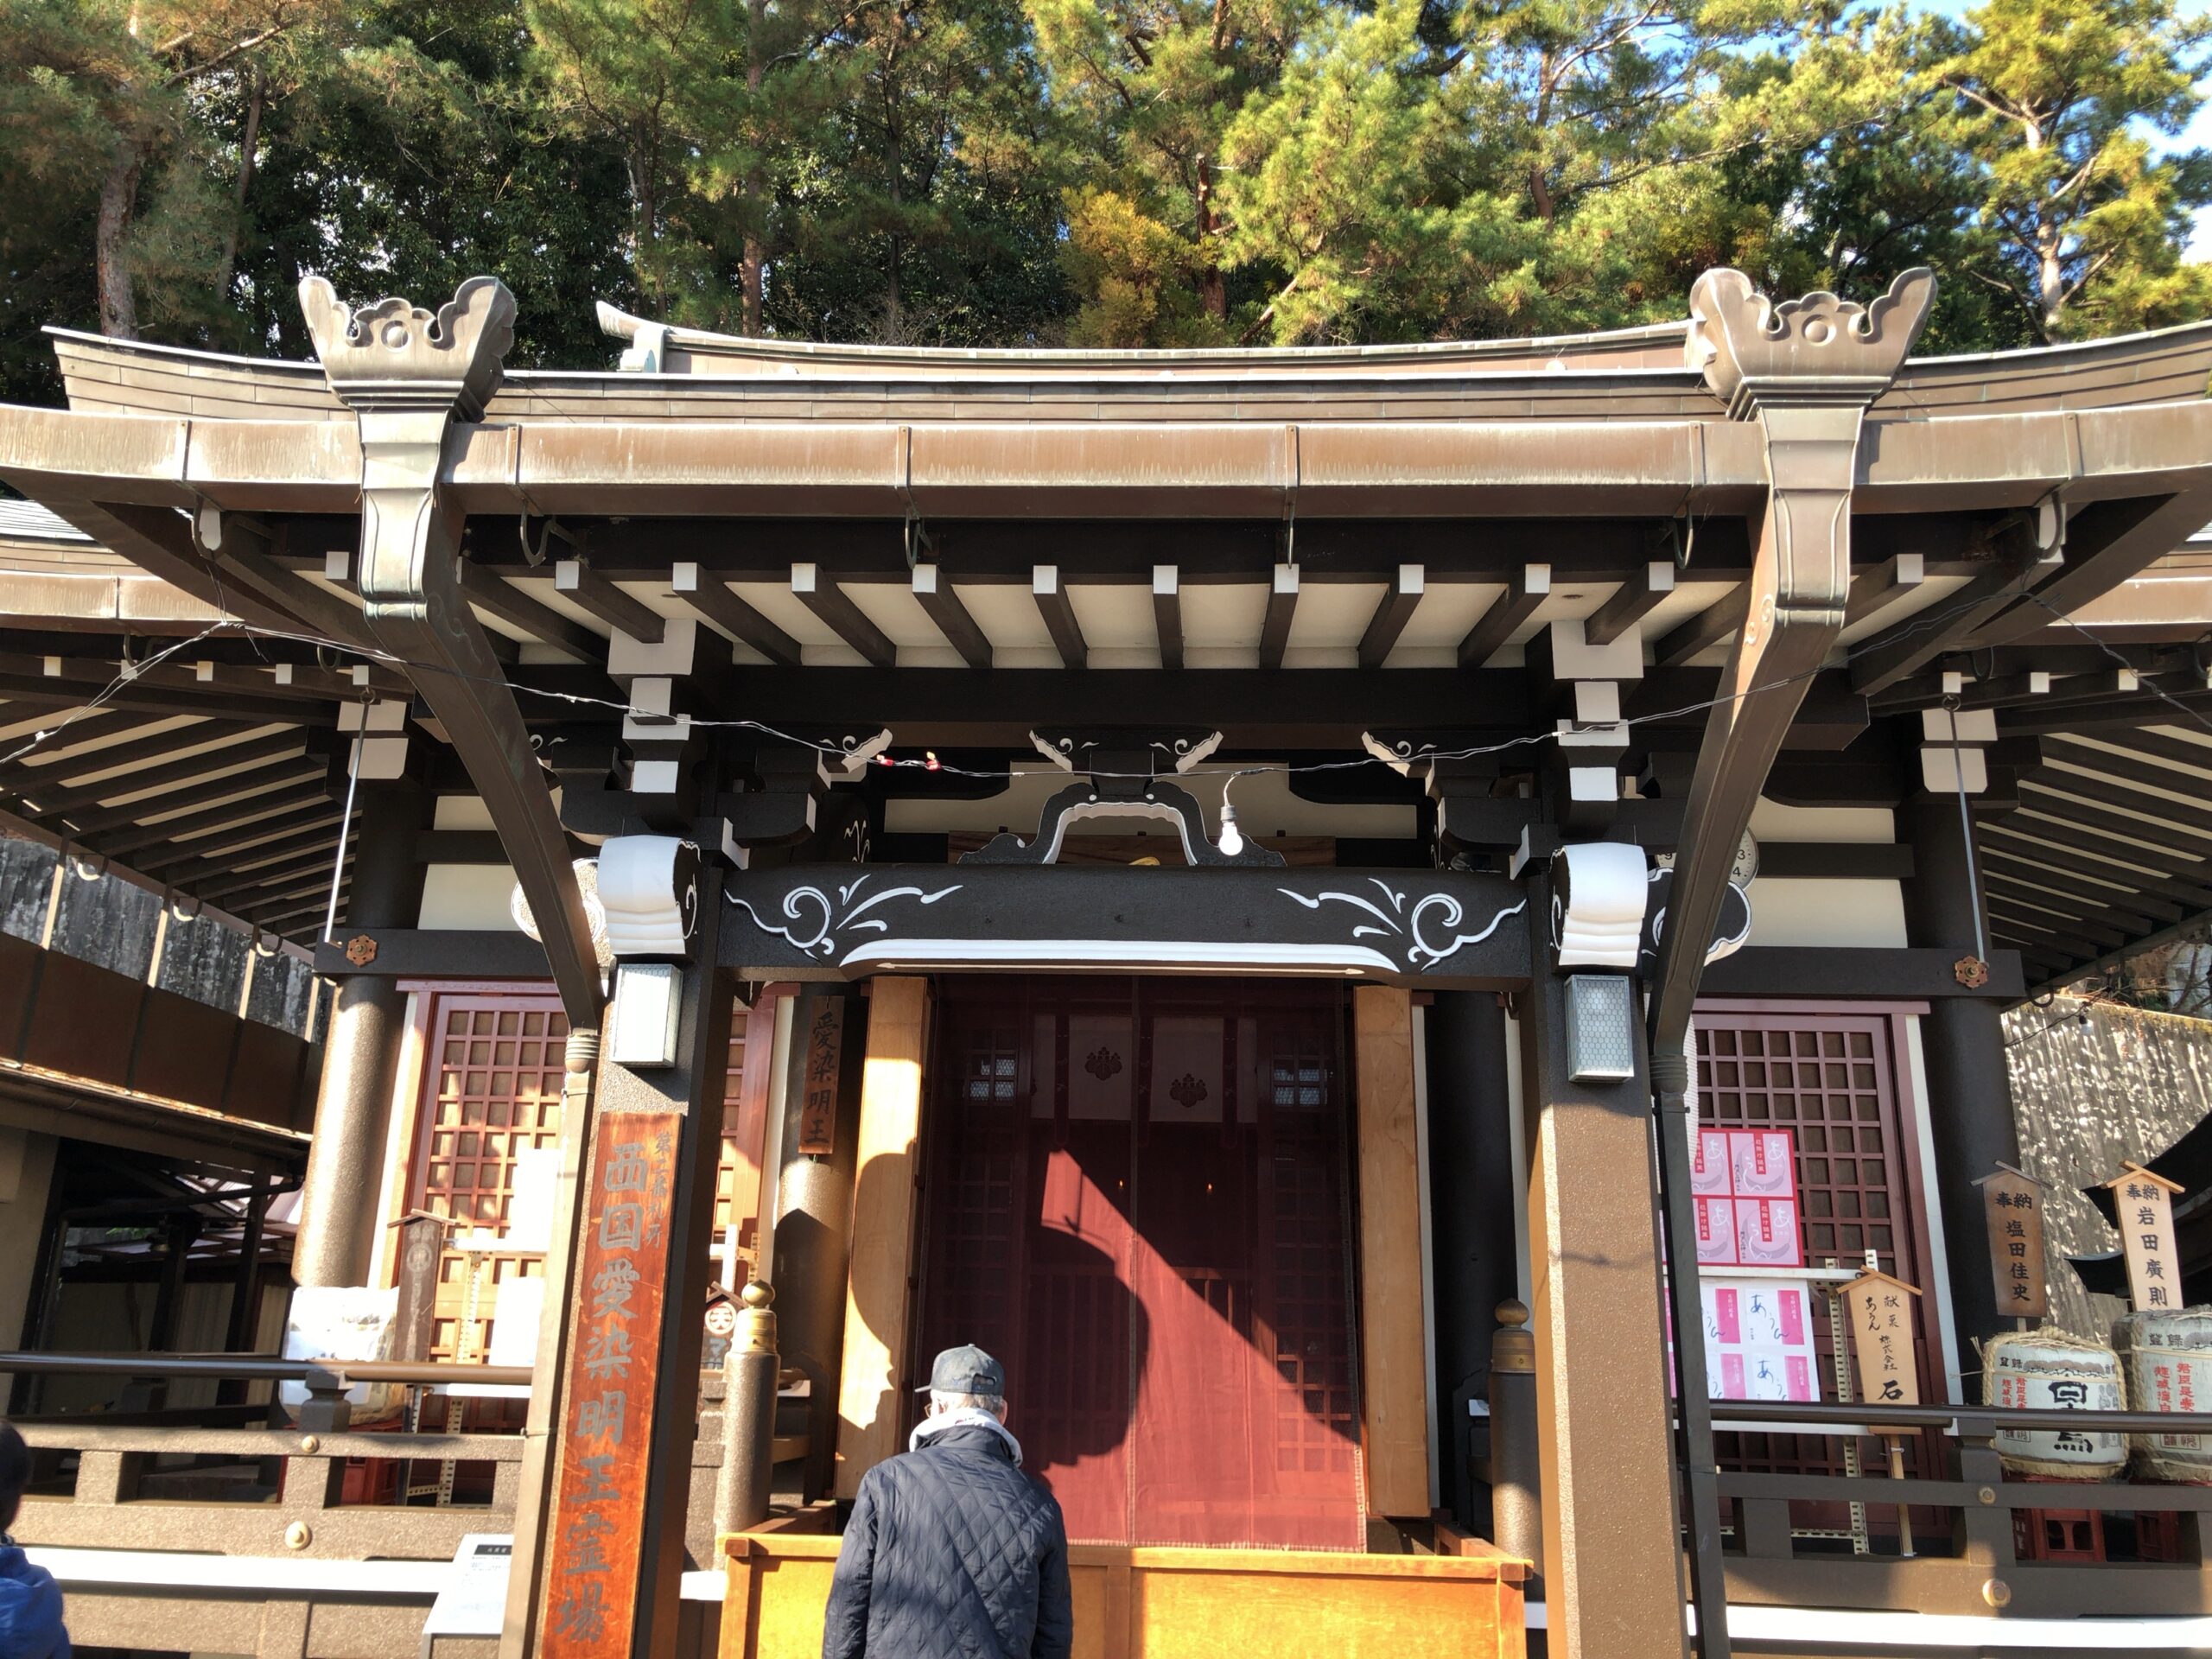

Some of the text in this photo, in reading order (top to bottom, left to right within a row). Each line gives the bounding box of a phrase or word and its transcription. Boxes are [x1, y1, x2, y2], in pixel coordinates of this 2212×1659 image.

[1732, 867, 1741, 876] 4
[804, 1011, 839, 1144] 愛染明王
[1995, 1191, 2032, 1210] 奉納
[2126, 1182, 2160, 1201] 奉納
[2005, 1219, 2031, 1301] 塩田佳史
[2137, 1205, 2168, 1307] 岩田廣則
[1866, 1296, 1880, 1332] あうん
[555, 1141, 647, 1643] 西国愛染明王霊場
